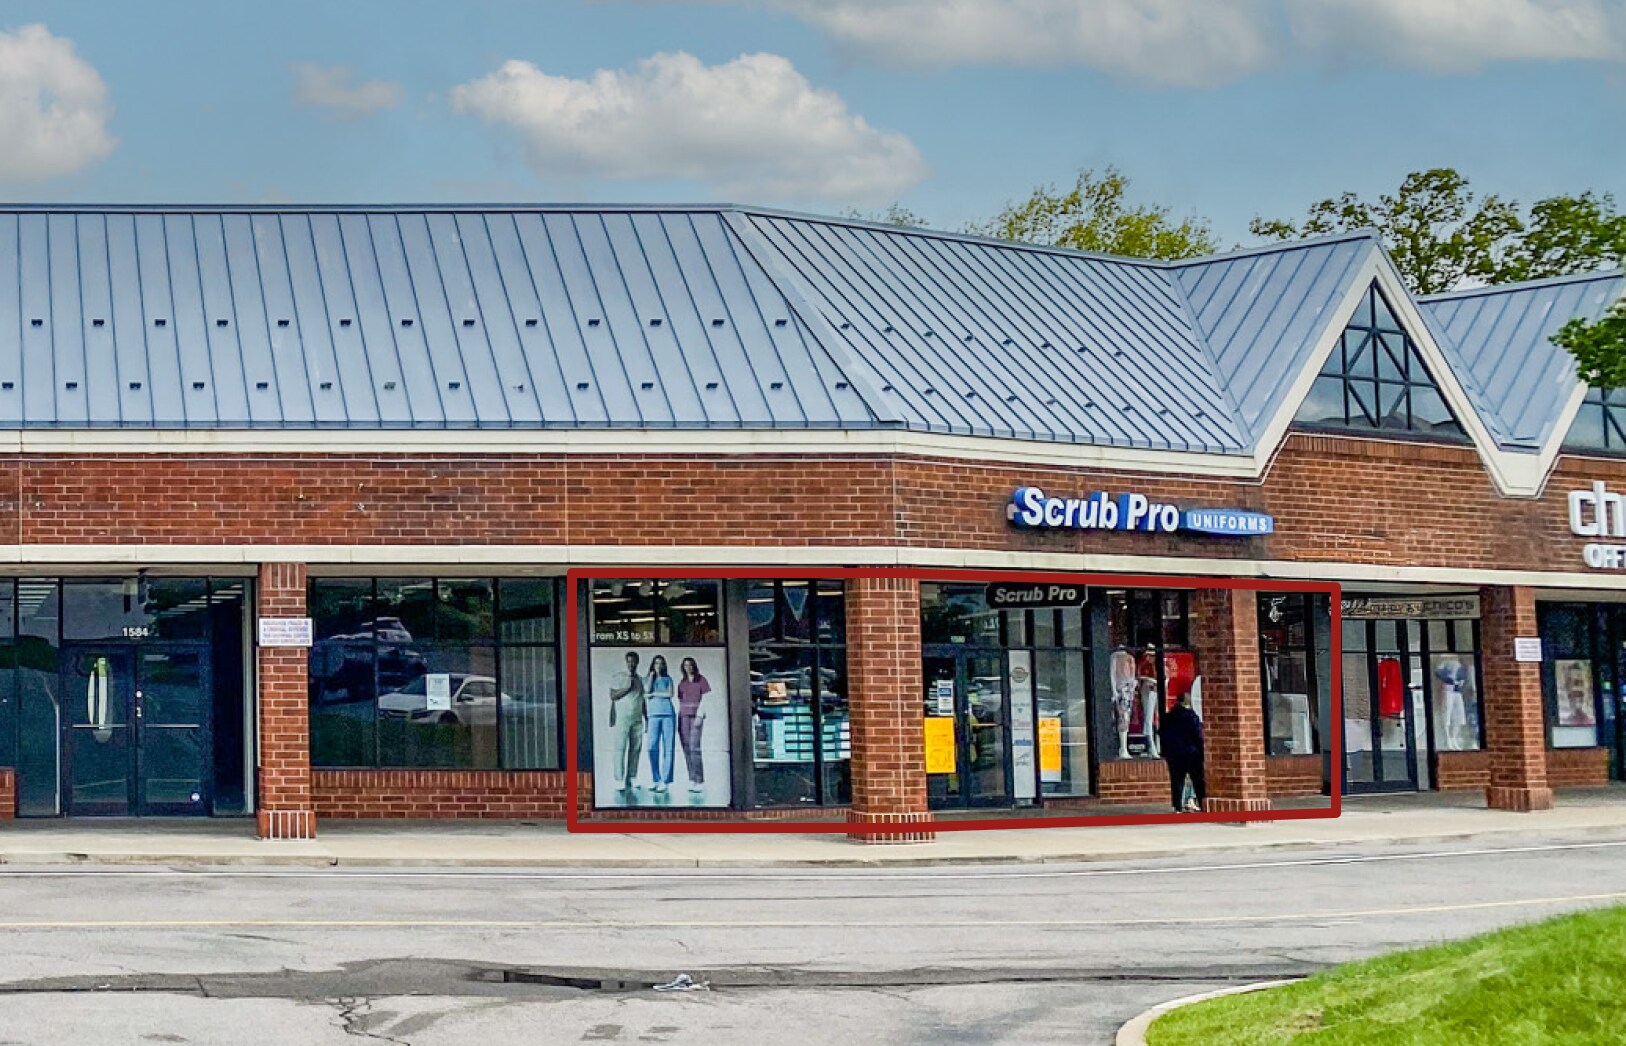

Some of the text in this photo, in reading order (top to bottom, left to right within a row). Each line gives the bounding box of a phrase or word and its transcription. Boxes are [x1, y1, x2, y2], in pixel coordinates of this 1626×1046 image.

[1016, 486, 1268, 532] Scrub Pro UNIFORMS
[994, 586, 1077, 603] Scrub Pro
